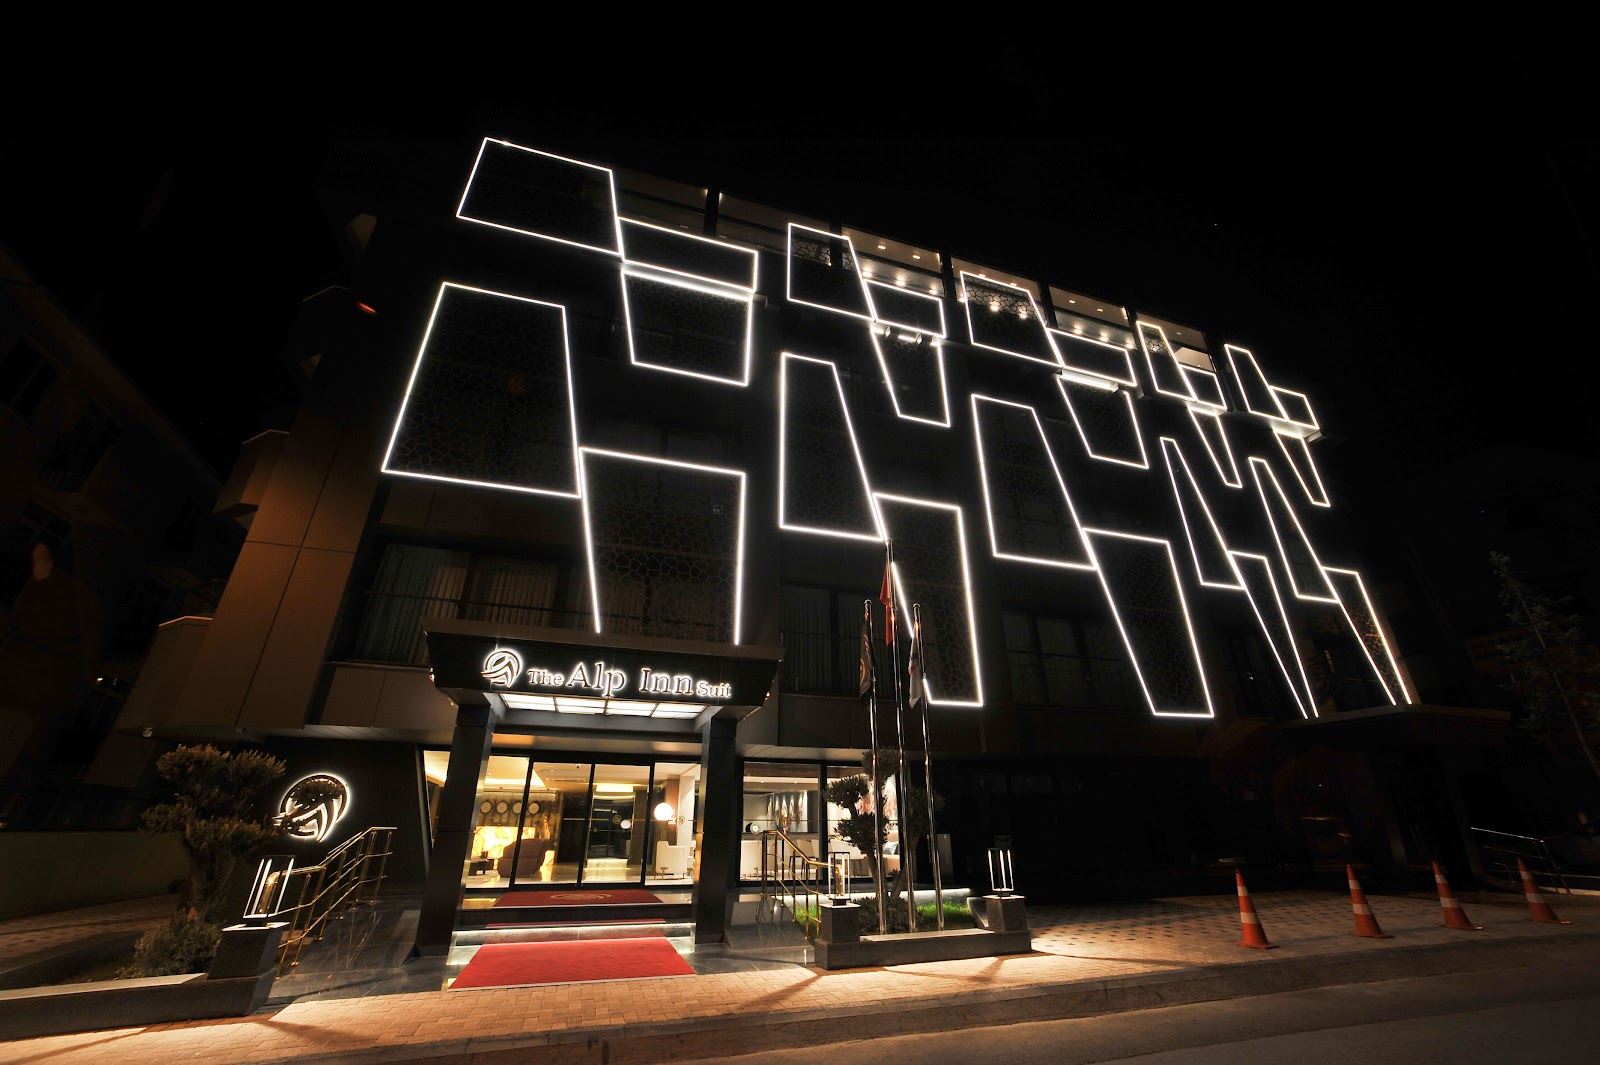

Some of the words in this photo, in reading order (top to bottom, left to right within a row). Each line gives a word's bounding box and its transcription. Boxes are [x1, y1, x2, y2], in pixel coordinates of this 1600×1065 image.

[527, 669, 565, 686] The
[566, 662, 626, 697] Alp
[639, 667, 694, 695] Inn
[696, 680, 732, 698] Suit
